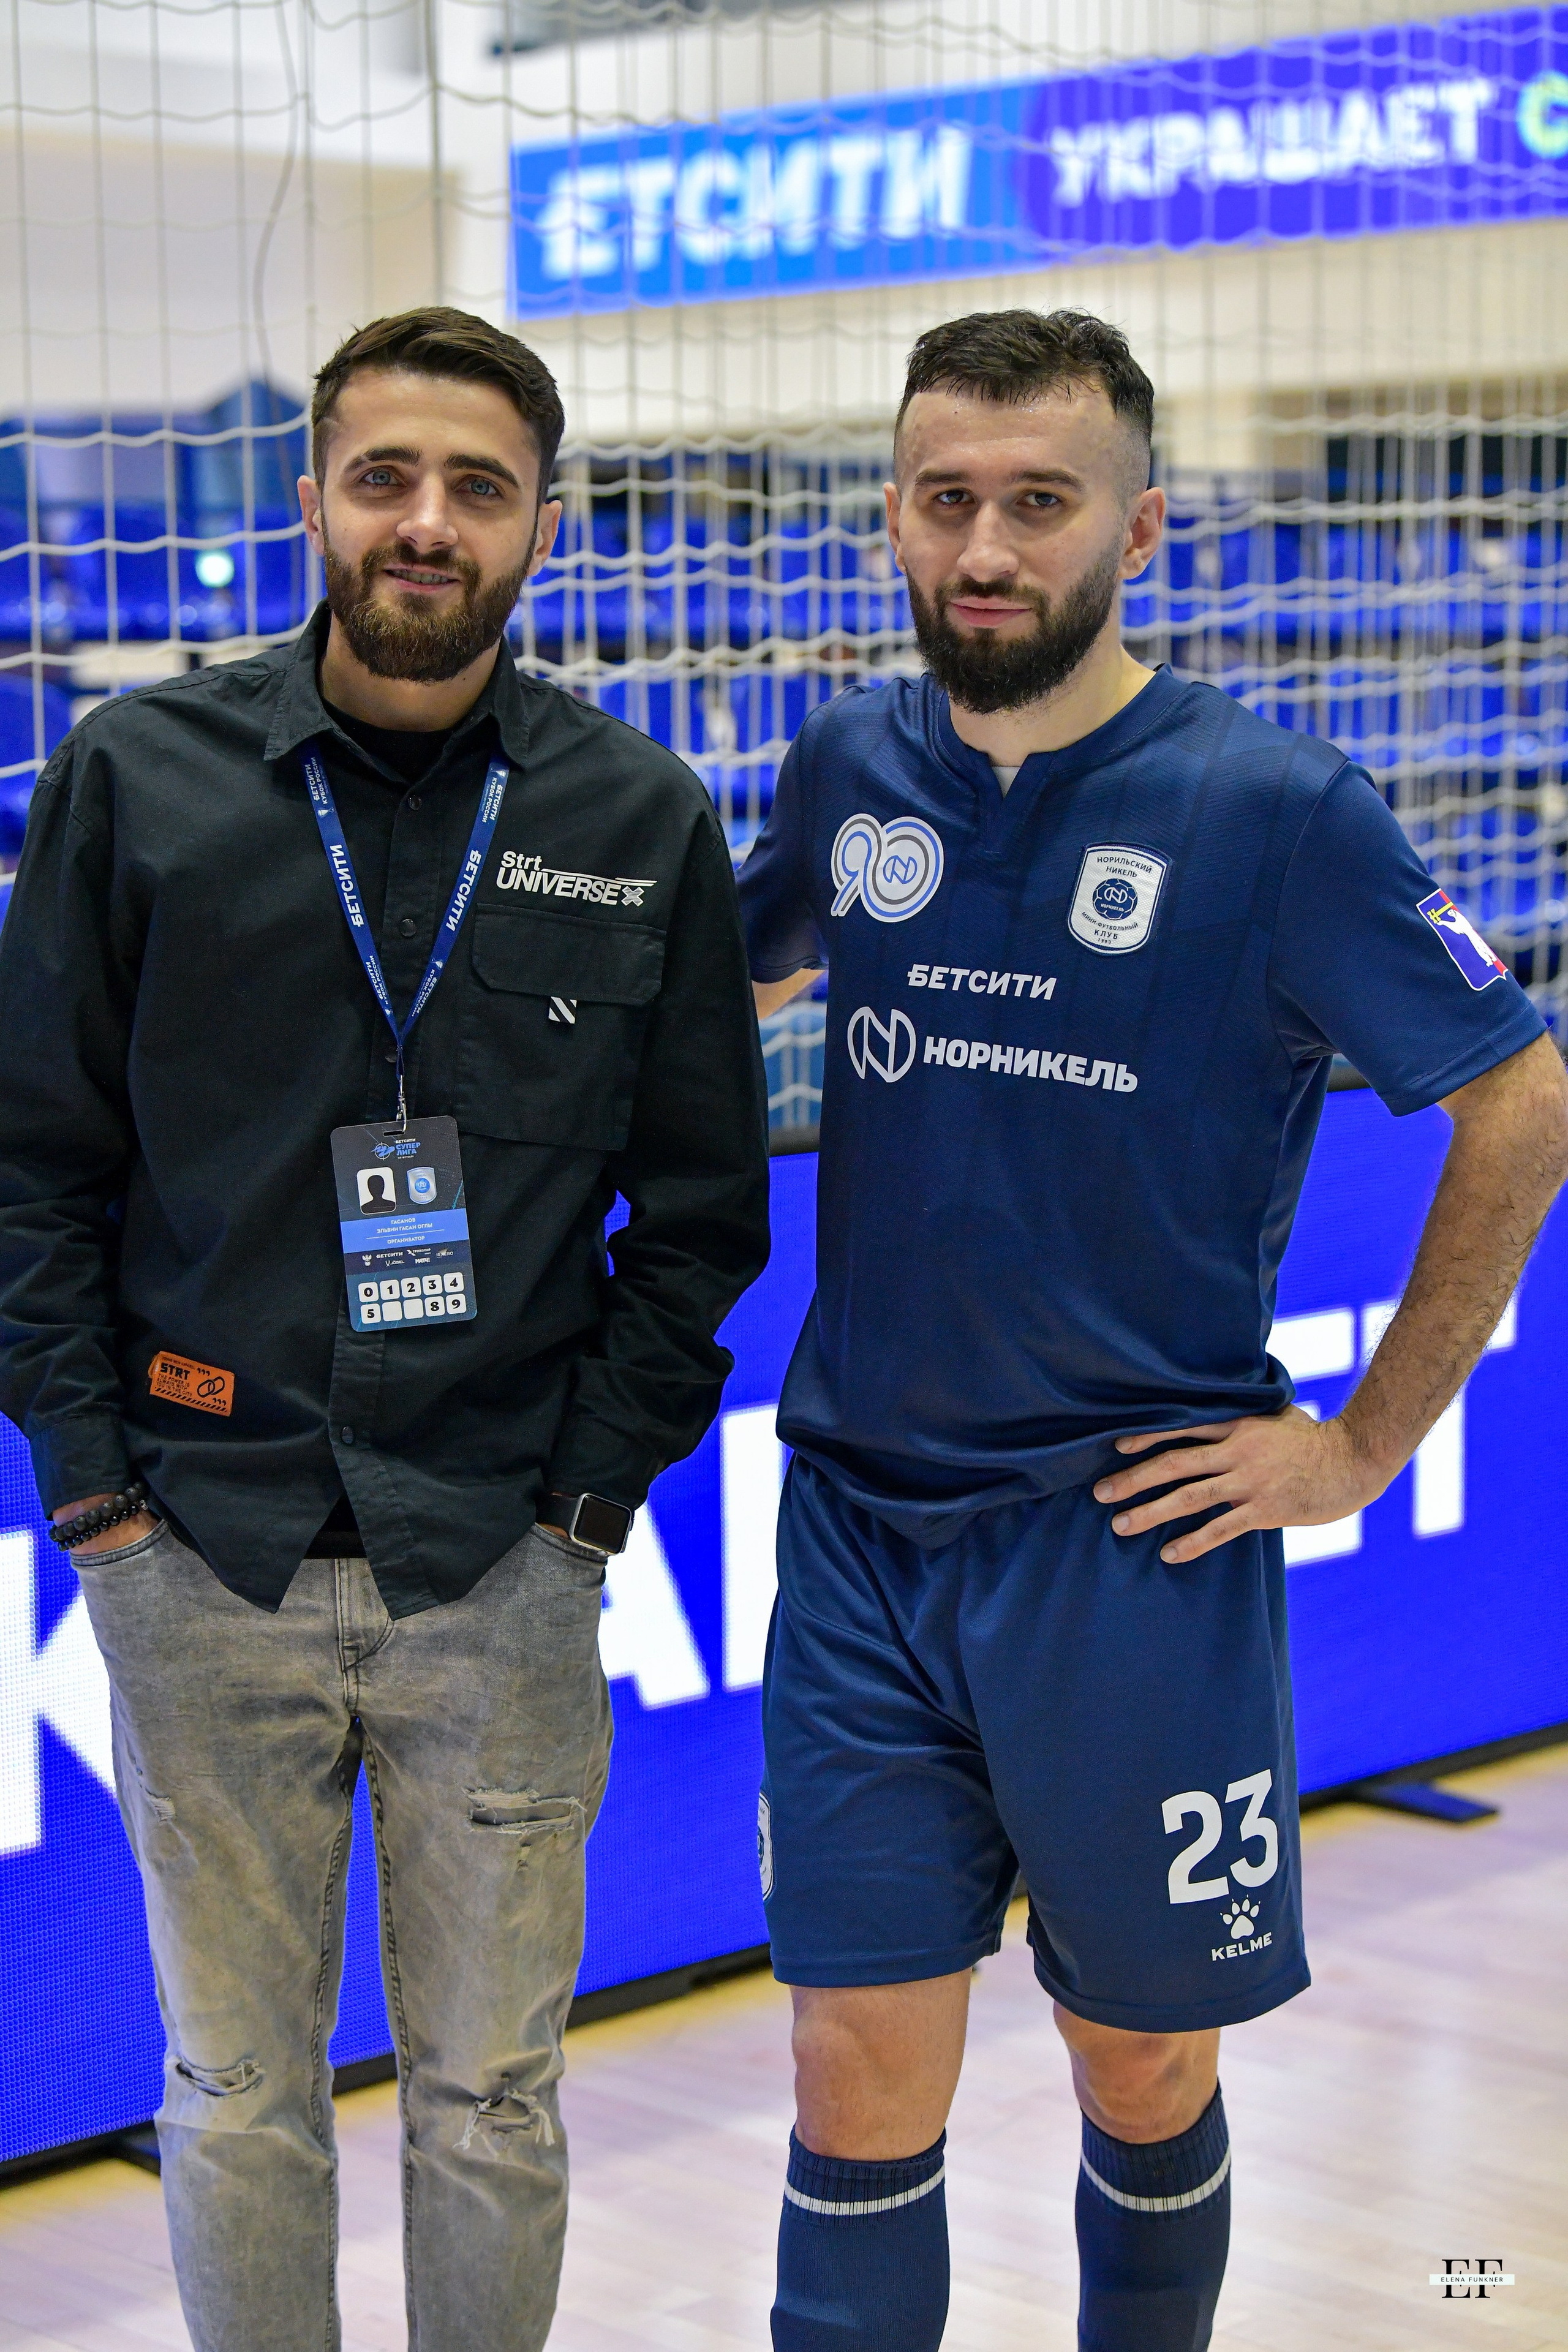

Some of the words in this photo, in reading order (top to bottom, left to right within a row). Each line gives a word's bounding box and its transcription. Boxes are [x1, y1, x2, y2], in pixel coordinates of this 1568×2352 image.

[1049, 75, 1497, 209] УКРАШАЕТ
[311, 757, 322, 782] РОССИИ
[304, 764, 320, 801] БЕТСИТИ
[317, 783, 328, 804] КУБОК
[488, 777, 497, 797] КУБОК
[482, 797, 492, 823] РОССИИ
[489, 784, 503, 821] БЕТСИТИ
[500, 851, 543, 871] Strt
[1096, 856, 1153, 873] НОРИЛЬСКИЙ
[1106, 865, 1137, 878] НИКЕЛЬ
[330, 844, 365, 927] БЕТСИТИ
[445, 849, 482, 932] БЕТСИТИ
[1100, 903, 1125, 912] НОРНИКЕЛЬ
[1081, 911, 1139, 931] МИНИ-ФУТБОЛЬНЫЙ
[1094, 929, 1118, 940] КЛУБ
[369, 956, 381, 982] РОССИИ
[423, 969, 435, 991] КУБОК
[366, 962, 383, 1000] БЕТСИТИ
[907, 963, 1057, 1000] БЕТСИТИ
[379, 982, 388, 1005] КУБОК
[417, 977, 437, 1014] БЕТСИТИ
[923, 1036, 1138, 1093] НОРНИКЕЛЬ
[364, 1286, 373, 1298] 0
[386, 1284, 393, 1295] 1
[407, 1282, 415, 1293] 2
[428, 1279, 437, 1290] 3
[449, 1277, 458, 1287] 4
[367, 1308, 375, 1319] 5
[430, 1300, 440, 1311] 8
[451, 1298, 461, 1309] 9
[157, 1378, 175, 1386] ALWAYS
[160, 1362, 190, 1380] STRT
[168, 1376, 184, 1385] POWER
[1161, 1768, 1278, 1904] 23
[1212, 1932, 1273, 1961] KELME
